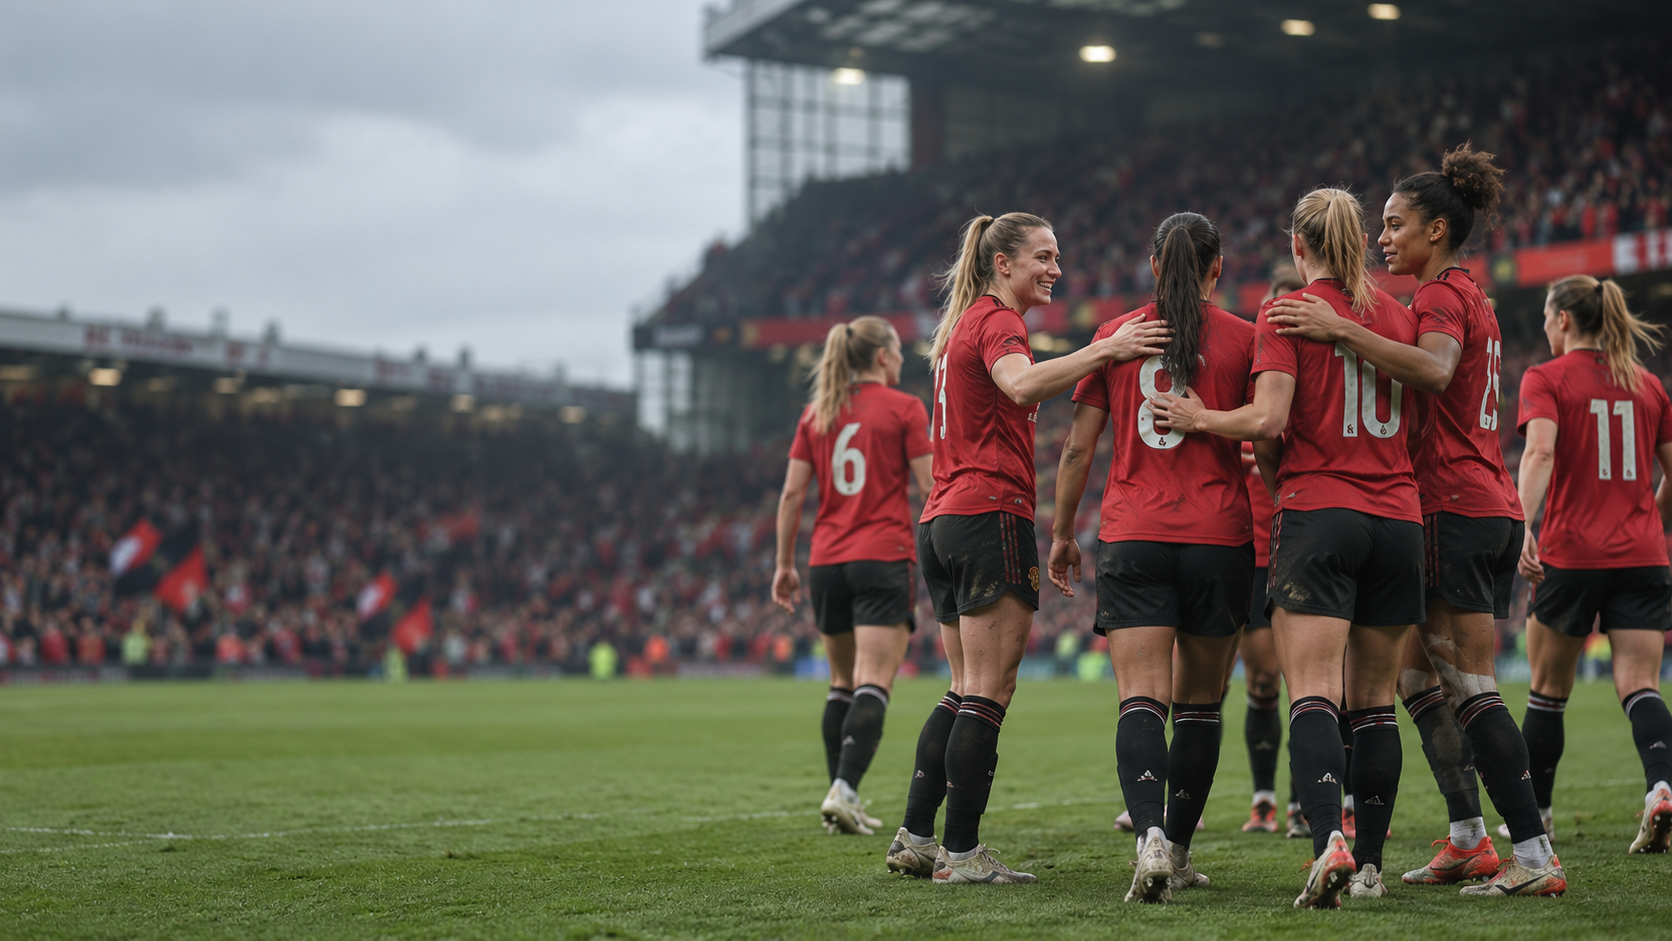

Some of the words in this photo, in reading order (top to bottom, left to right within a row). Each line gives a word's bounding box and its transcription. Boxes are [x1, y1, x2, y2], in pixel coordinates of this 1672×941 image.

[1137, 354, 1186, 449] 8
[1335, 342, 1402, 438] 10
[832, 422, 866, 496] 6
[1590, 399, 1637, 481] 11
